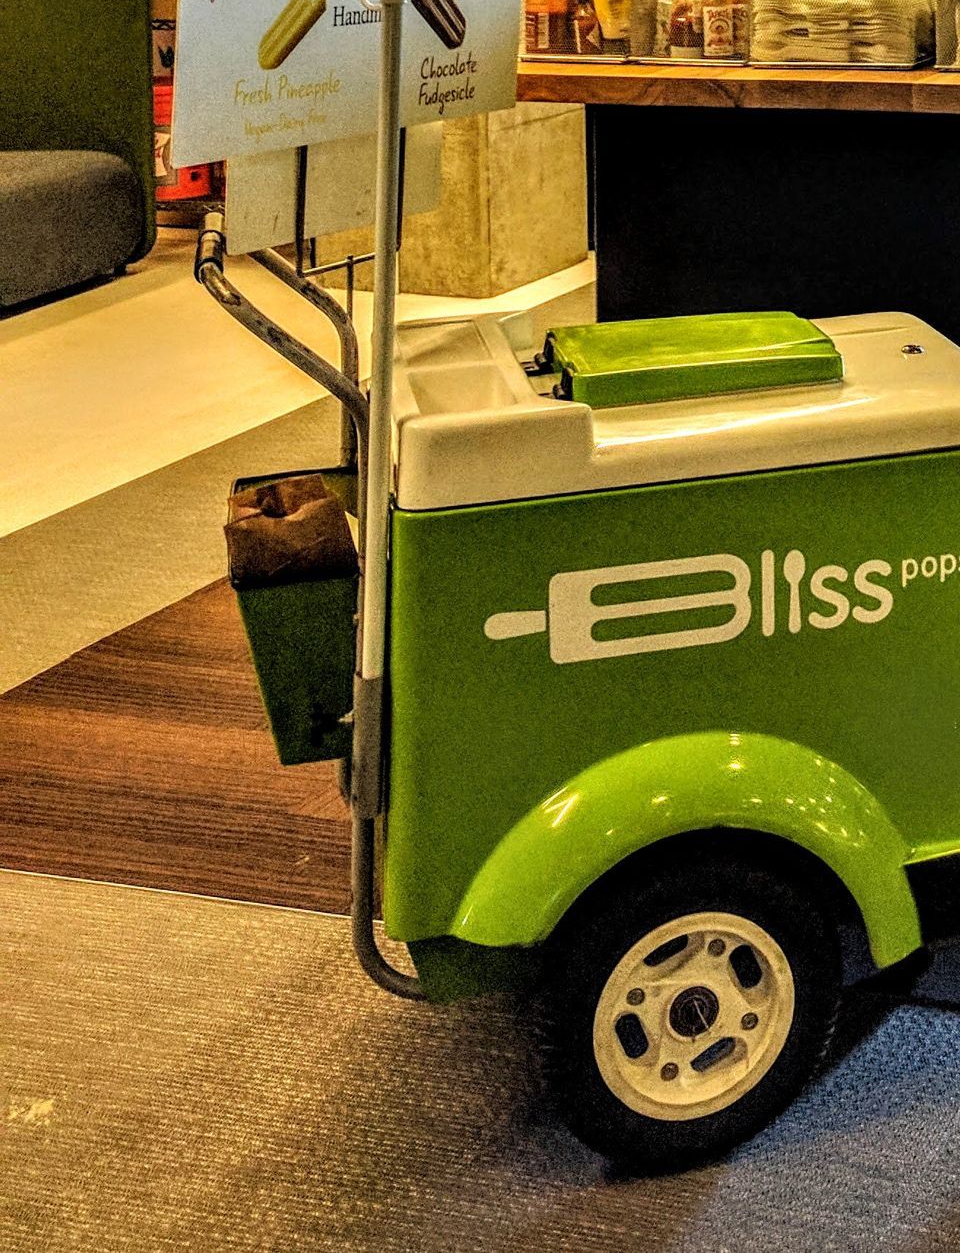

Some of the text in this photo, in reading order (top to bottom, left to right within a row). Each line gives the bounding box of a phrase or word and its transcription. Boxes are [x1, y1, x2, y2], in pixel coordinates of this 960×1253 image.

[333, 6, 384, 27] Handm
[420, 50, 478, 80] Chocolate
[234, 71, 341, 106] Fresh Pineapple
[418, 77, 476, 115] Fudgesicle
[549, 549, 894, 664] Bliss
